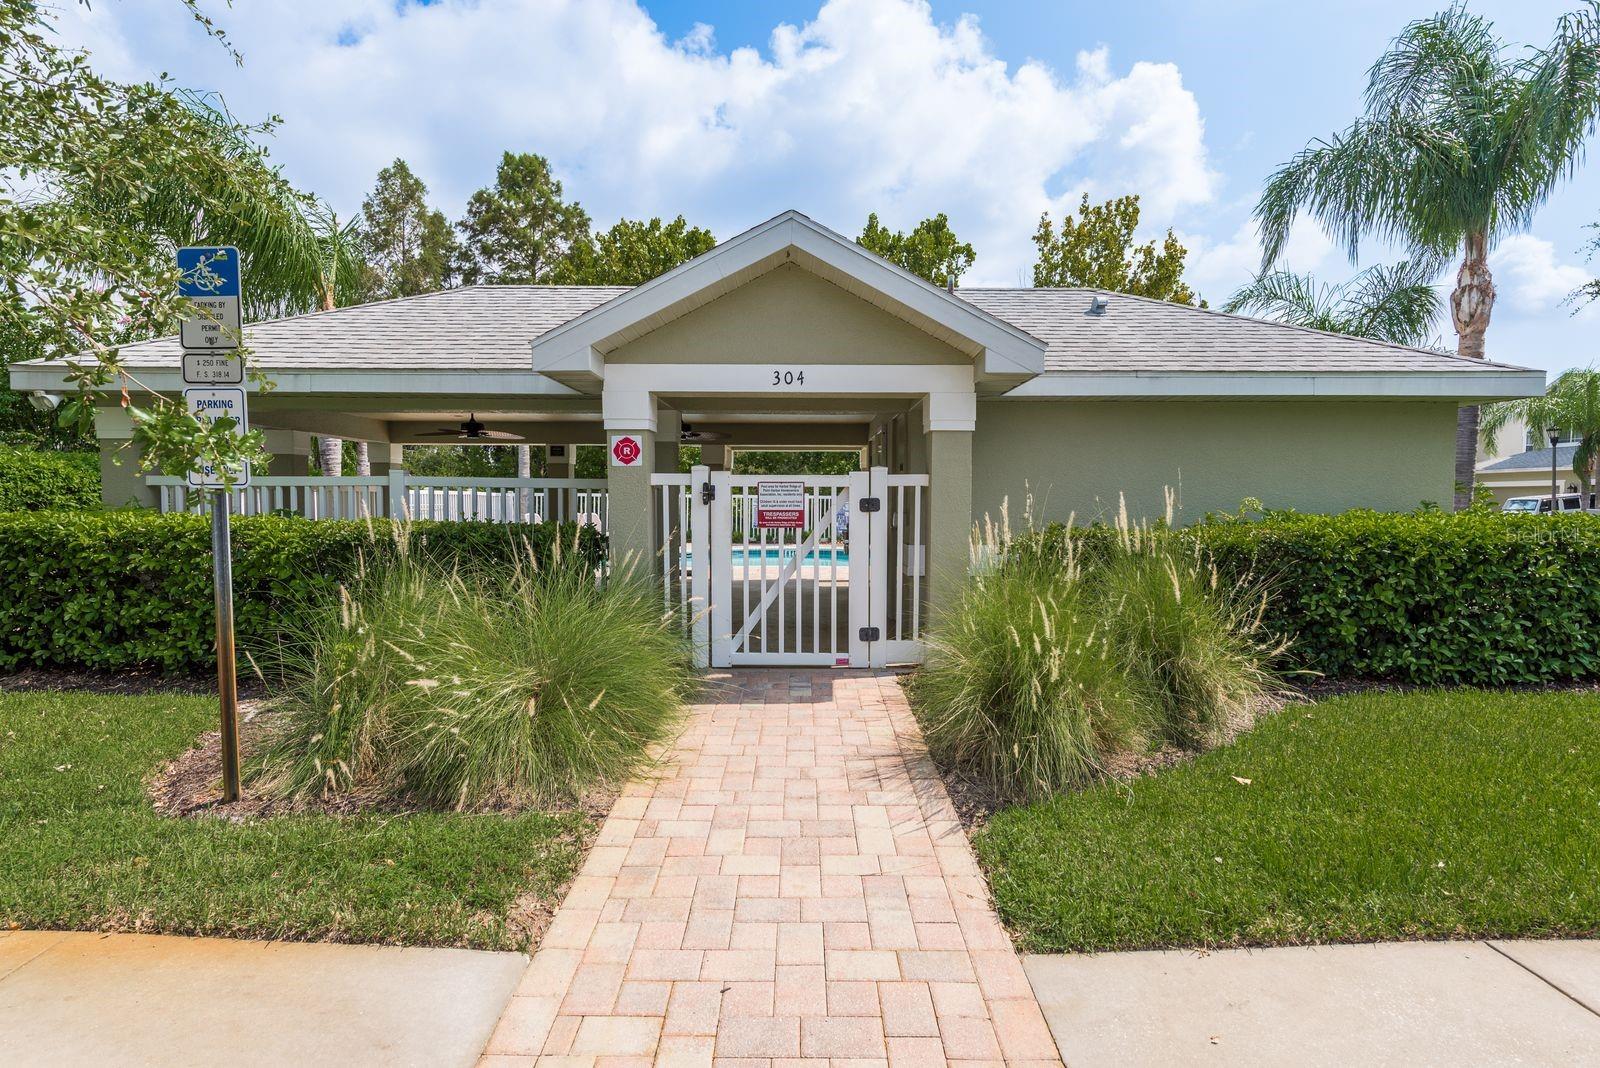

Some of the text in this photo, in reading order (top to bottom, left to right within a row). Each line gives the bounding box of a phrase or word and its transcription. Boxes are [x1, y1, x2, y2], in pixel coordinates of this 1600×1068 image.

[219, 301, 226, 309] BY
[202, 359, 214, 367] 250
[215, 359, 229, 367] FINE
[772, 370, 805, 386] 304
[196, 399, 233, 409] PARKING
[623, 447, 631, 455] R
